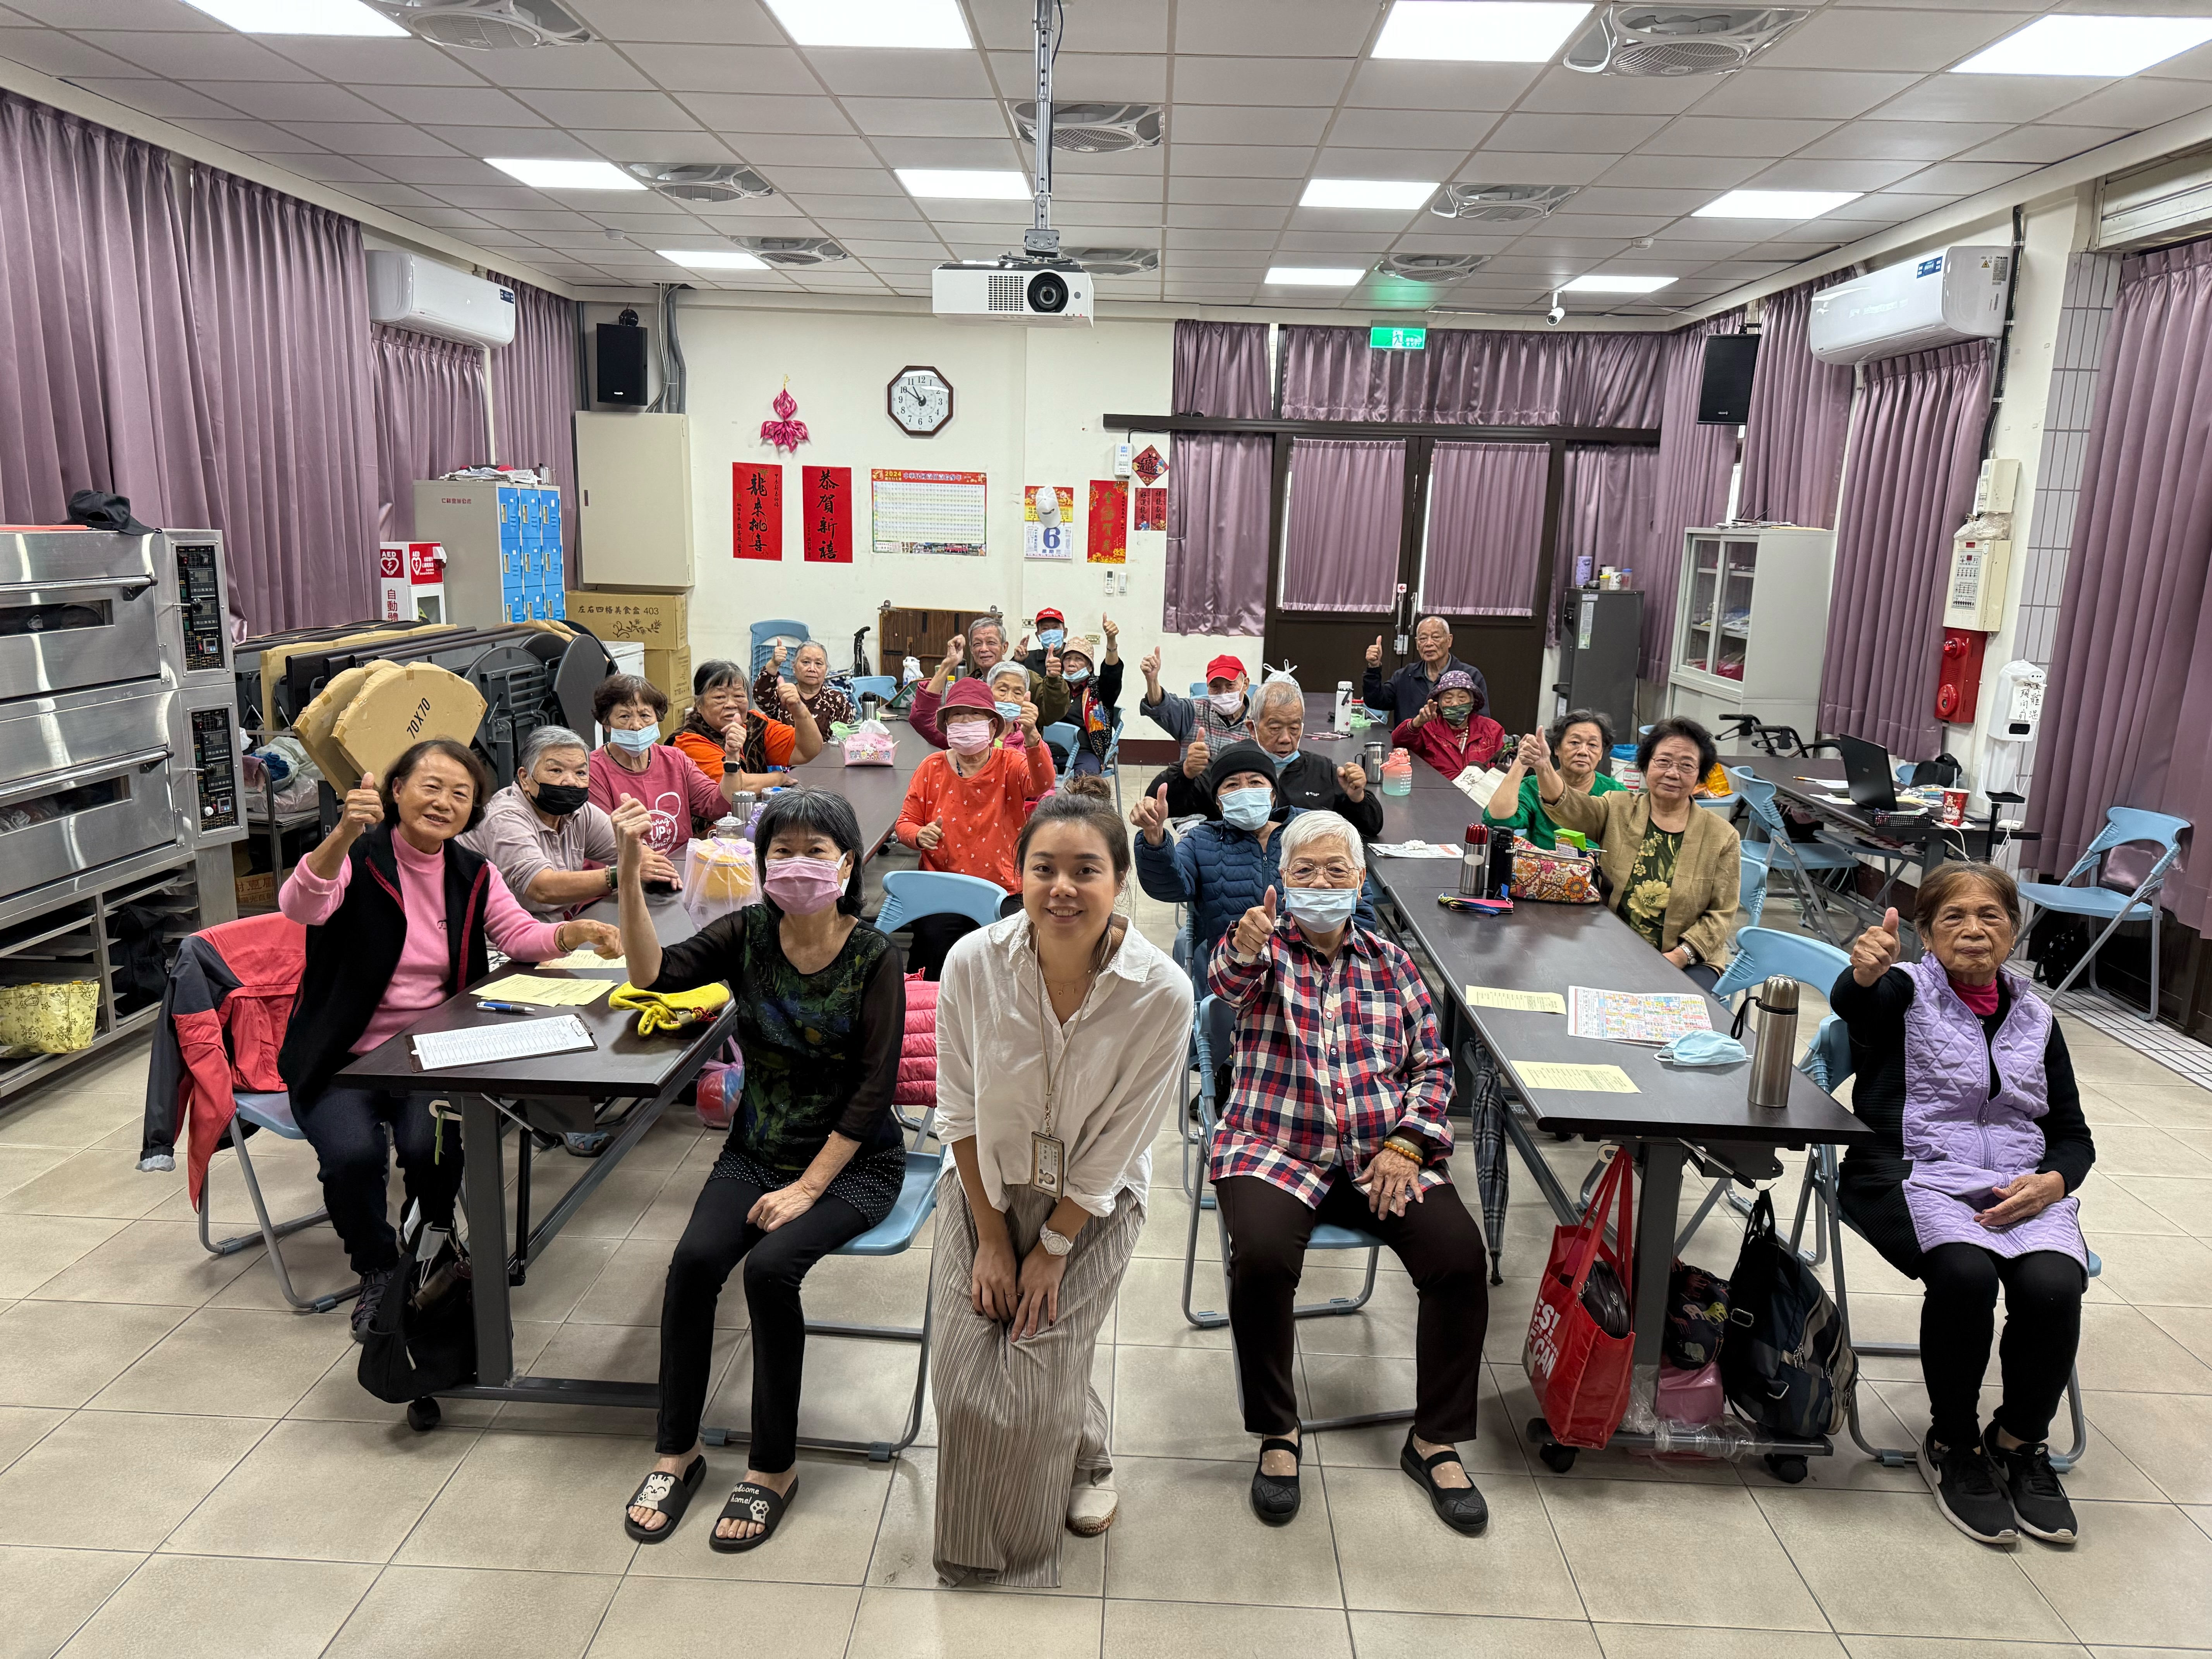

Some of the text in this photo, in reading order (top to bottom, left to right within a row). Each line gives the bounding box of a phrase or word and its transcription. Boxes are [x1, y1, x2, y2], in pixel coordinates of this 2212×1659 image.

[746, 472, 768, 552] 龍來桃喜
[816, 469, 840, 559] 恭賀新禧
[1043, 527, 1061, 549] 6
[578, 605, 640, 615] 左右四格美食盒
[407, 697, 430, 739] 70X70
[650, 826, 666, 841] UP
[1532, 1338, 1556, 1380] CAN
[730, 1494, 752, 1504] home!
